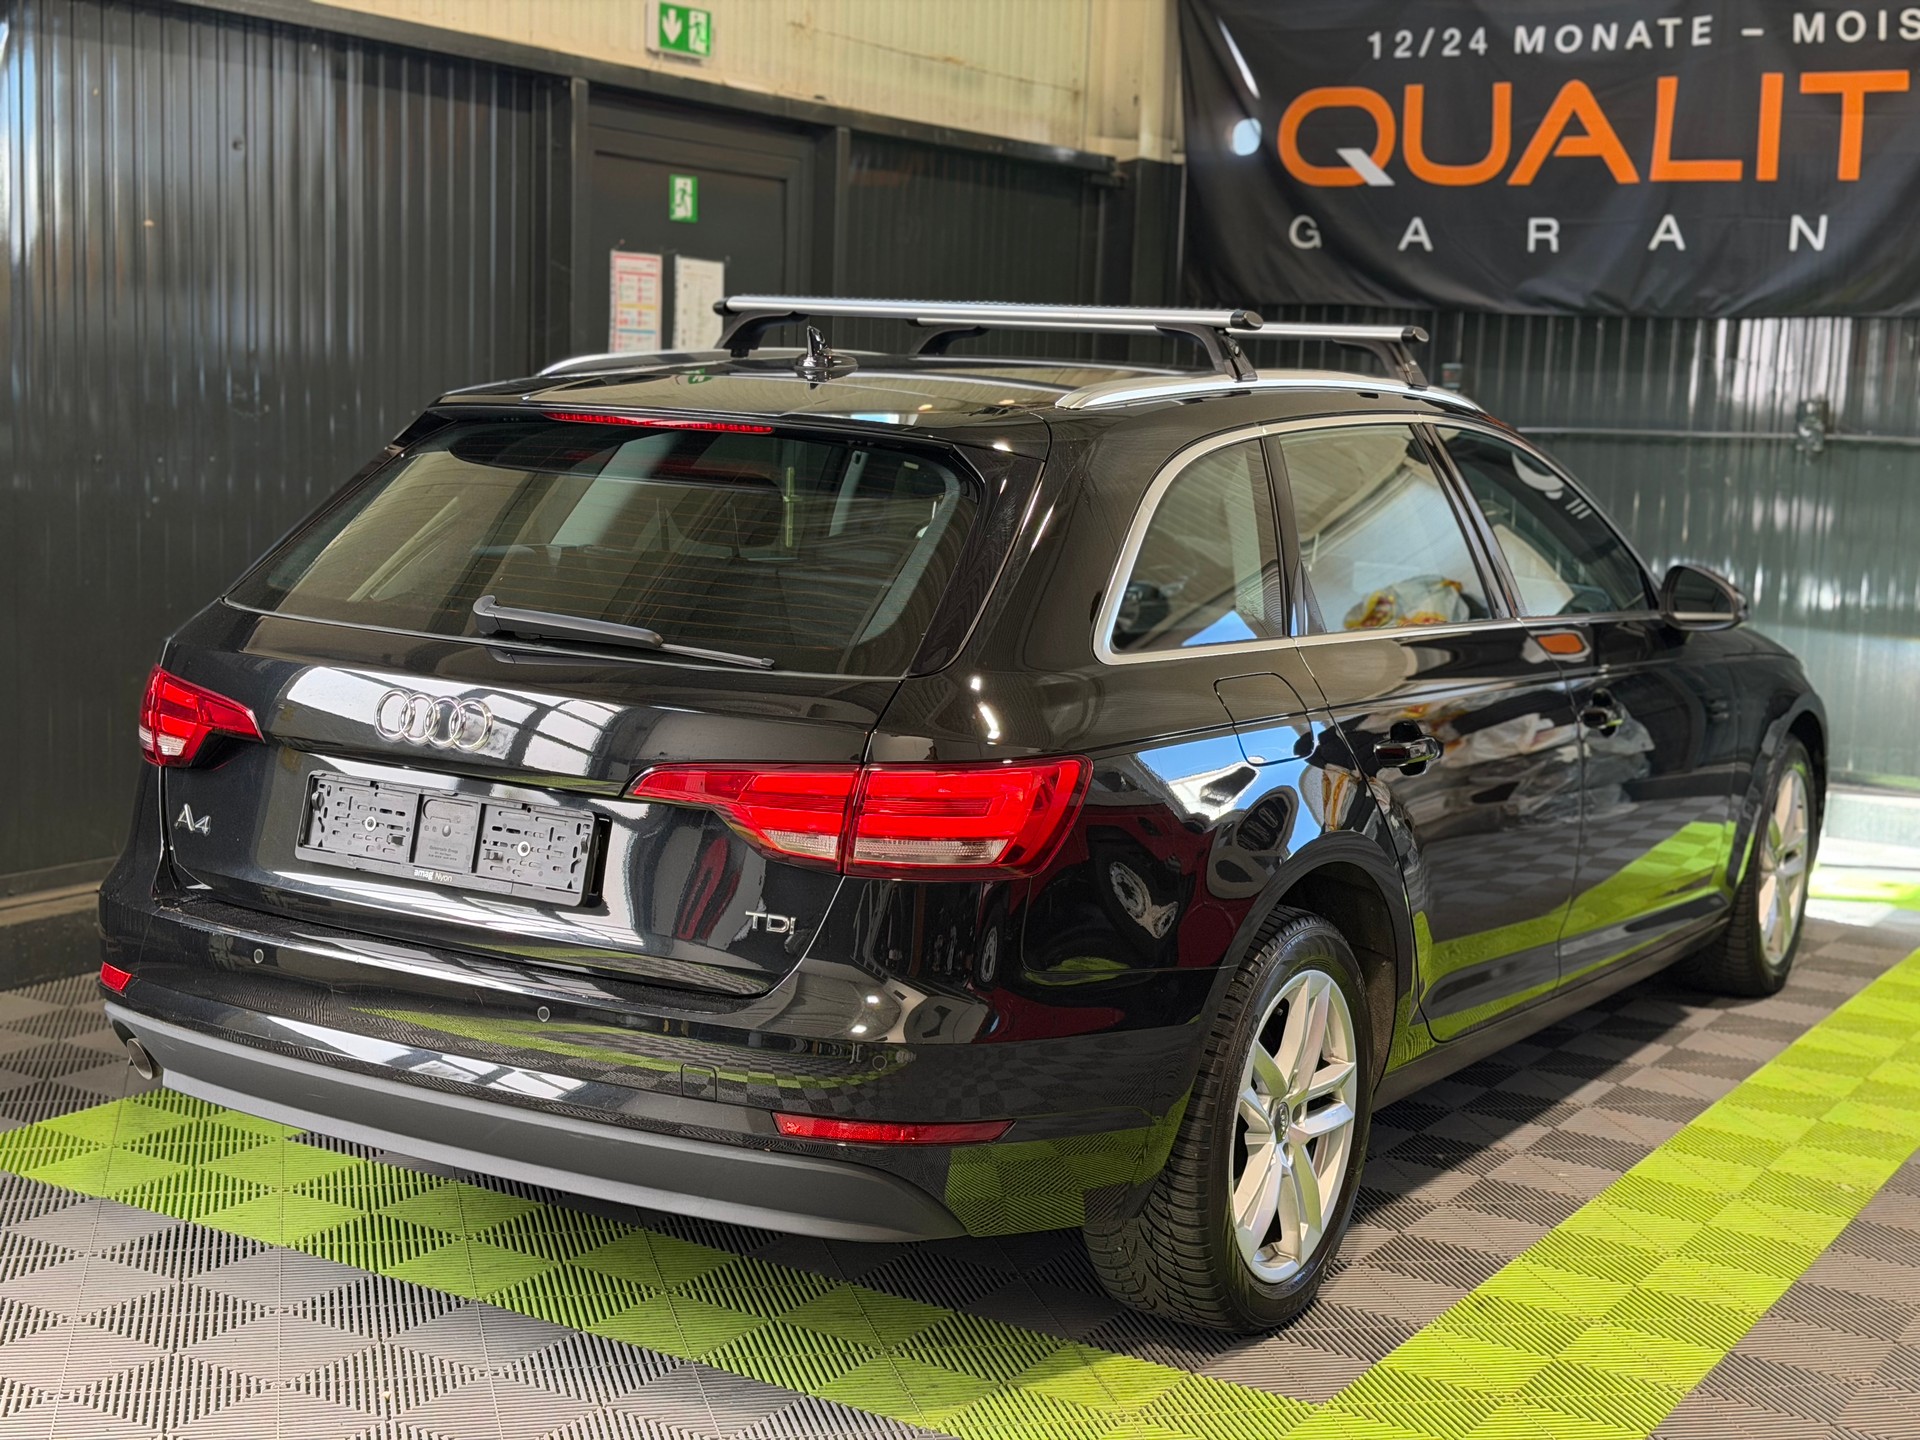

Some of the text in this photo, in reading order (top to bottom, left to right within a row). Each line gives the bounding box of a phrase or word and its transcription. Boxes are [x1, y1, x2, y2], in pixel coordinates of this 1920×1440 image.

[1367, 26, 1488, 59] 12/24
[1514, 14, 1713, 55] MONATE
[1793, 7, 1920, 44] MOIS
[1277, 69, 1910, 187] QUALIT
[174, 803, 211, 836] A4
[413, 869, 453, 882] amag Nyon
[745, 910, 796, 935] TDI
